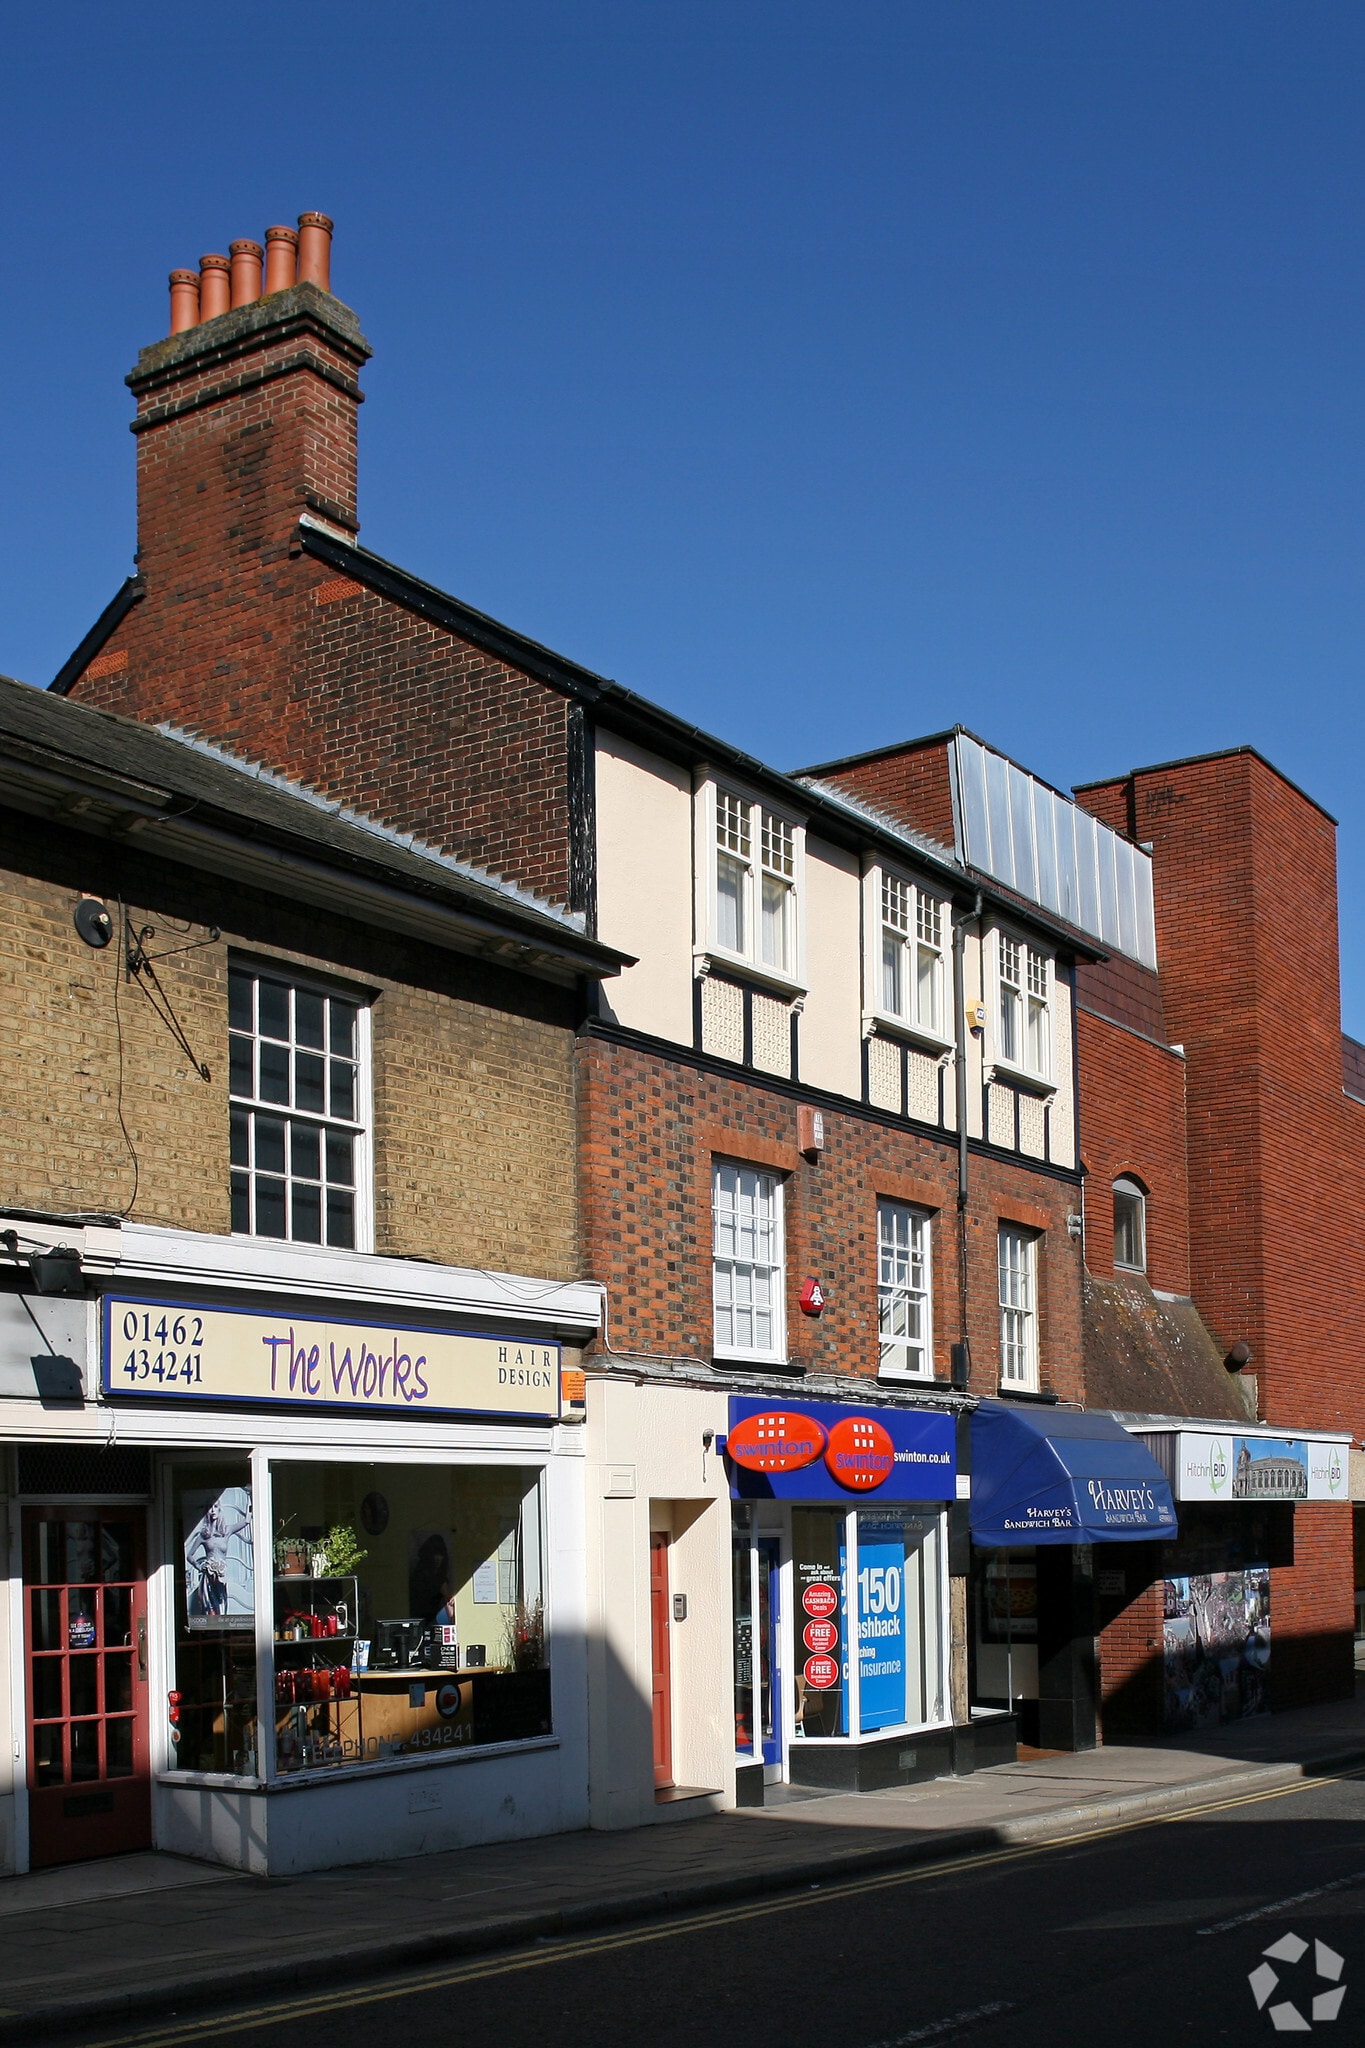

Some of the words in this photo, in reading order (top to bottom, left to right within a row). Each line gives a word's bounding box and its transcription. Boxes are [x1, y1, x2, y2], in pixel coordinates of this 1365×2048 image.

[123, 1311, 204, 1346] 01462
[262, 1326, 321, 1395] The
[330, 1337, 429, 1402] Works
[499, 1346, 552, 1366] HAIR
[123, 1349, 203, 1385] 434241
[499, 1368, 552, 1387] DESIGN
[735, 1440, 813, 1457] swinton
[893, 1450, 951, 1465] swinton.co.uk
[836, 1452, 890, 1471] swinton
[1186, 1462, 1211, 1477] Hitchin
[1213, 1463, 1226, 1477] BID
[1331, 1467, 1341, 1480] BID
[810, 1629, 831, 1637] FREE
[857, 1615, 901, 1639] ashback
[811, 1666, 831, 1674] FREE
[860, 1660, 901, 1677] Insurance
[410, 1722, 473, 1748] 434241
